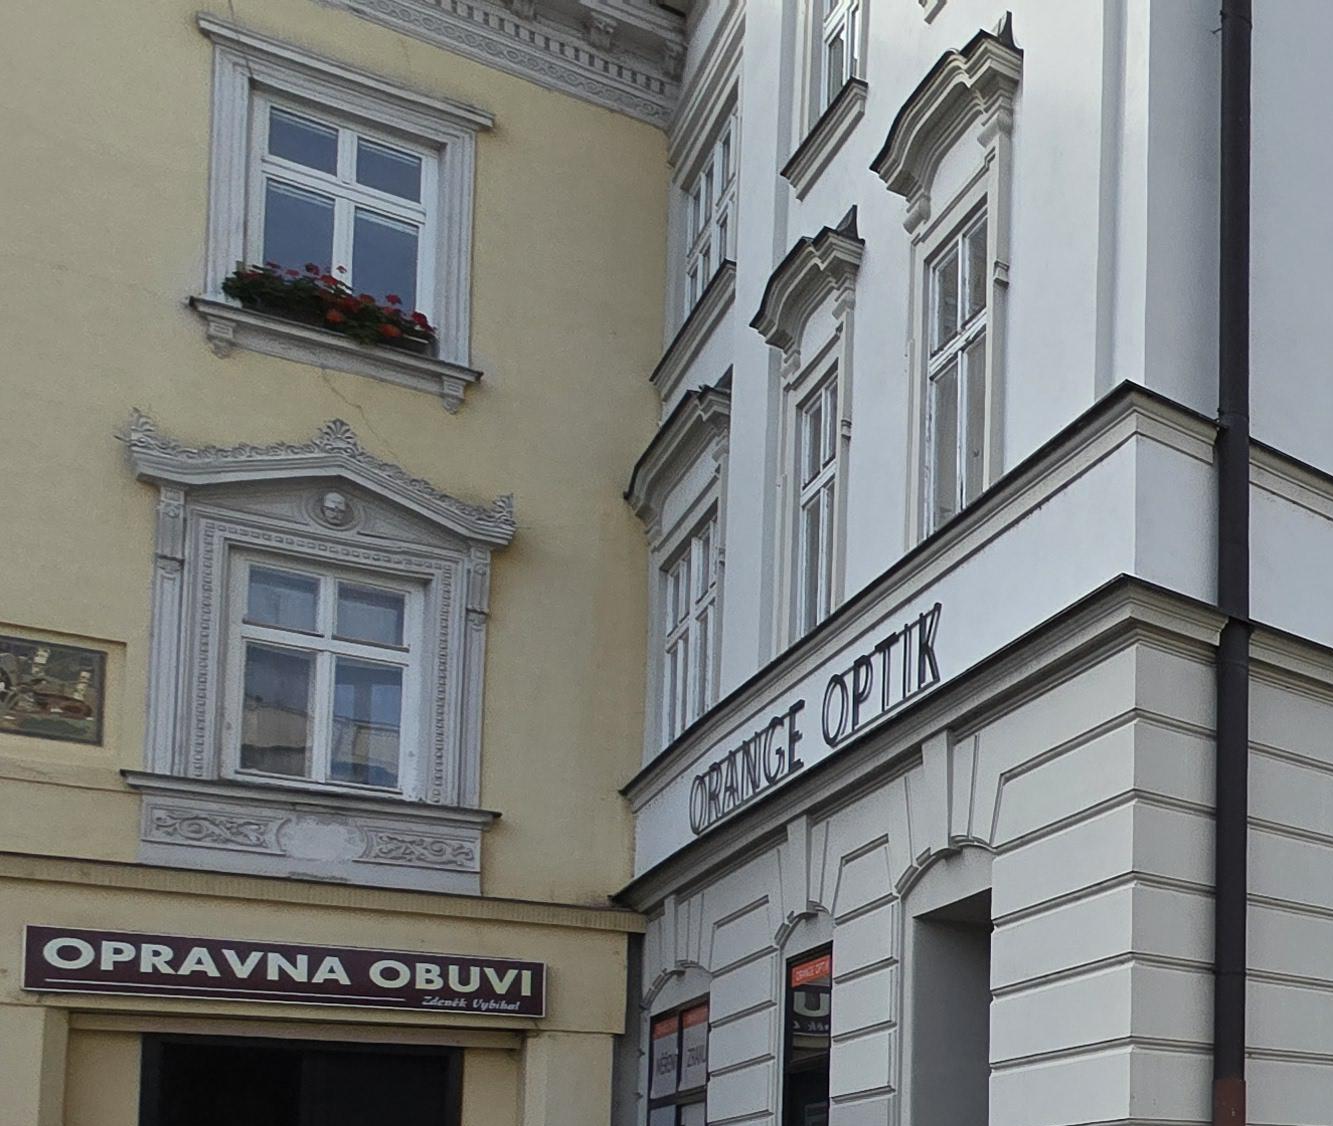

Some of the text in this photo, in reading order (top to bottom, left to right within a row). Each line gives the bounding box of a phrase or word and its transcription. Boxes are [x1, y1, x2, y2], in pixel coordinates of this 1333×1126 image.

[689, 602, 942, 835] ORANGE OPTIK
[42, 937, 532, 997] OPRAVNA OBUVI
[421, 995, 467, 1008] Zdeněk
